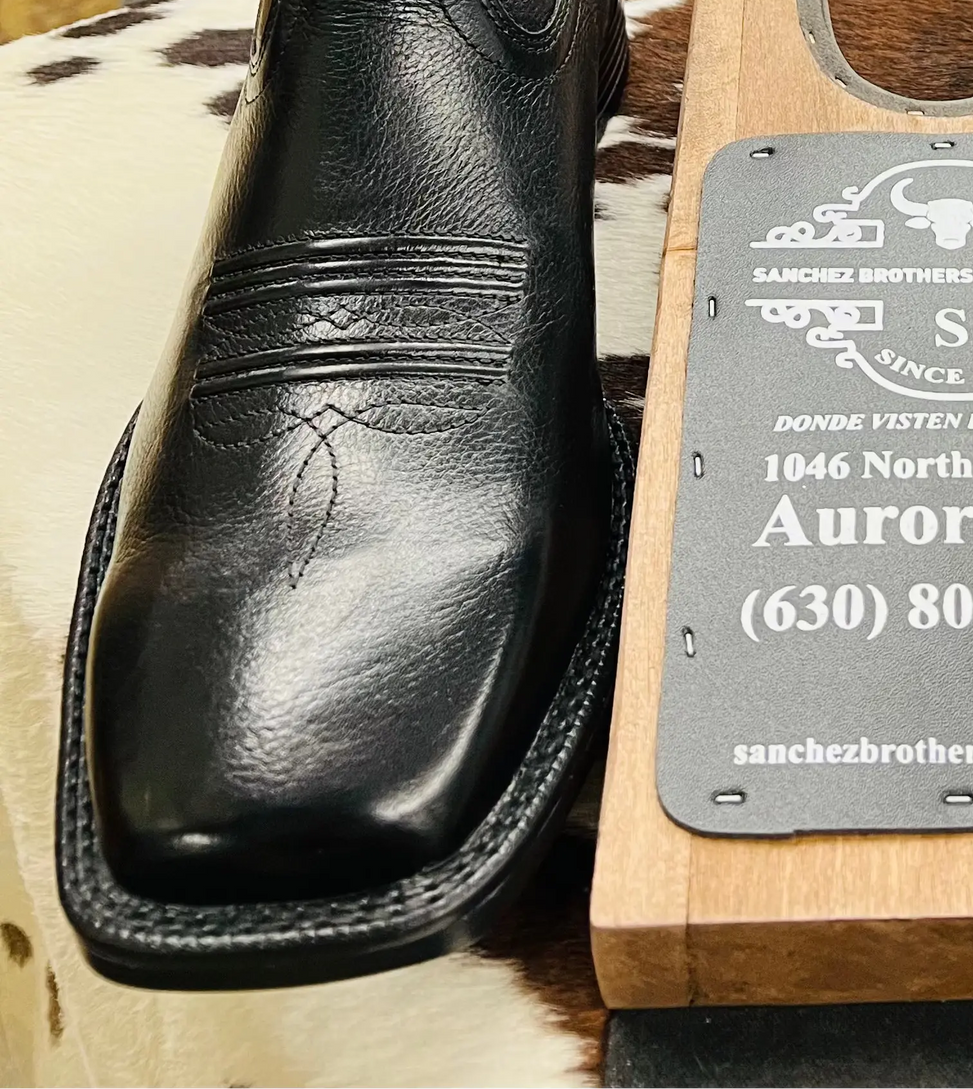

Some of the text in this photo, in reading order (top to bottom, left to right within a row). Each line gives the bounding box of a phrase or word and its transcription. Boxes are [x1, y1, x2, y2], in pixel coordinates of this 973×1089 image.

[752, 267, 854, 284] SANCHEZ
[858, 267, 973, 284] BROTHERS
[934, 307, 970, 348] S
[874, 348, 966, 385] SINCE
[773, 414, 866, 433] DONDE
[872, 412, 963, 430] VISTEN
[763, 452, 851, 483] 1046
[861, 450, 973, 481] North
[740, 583, 890, 642] (630)
